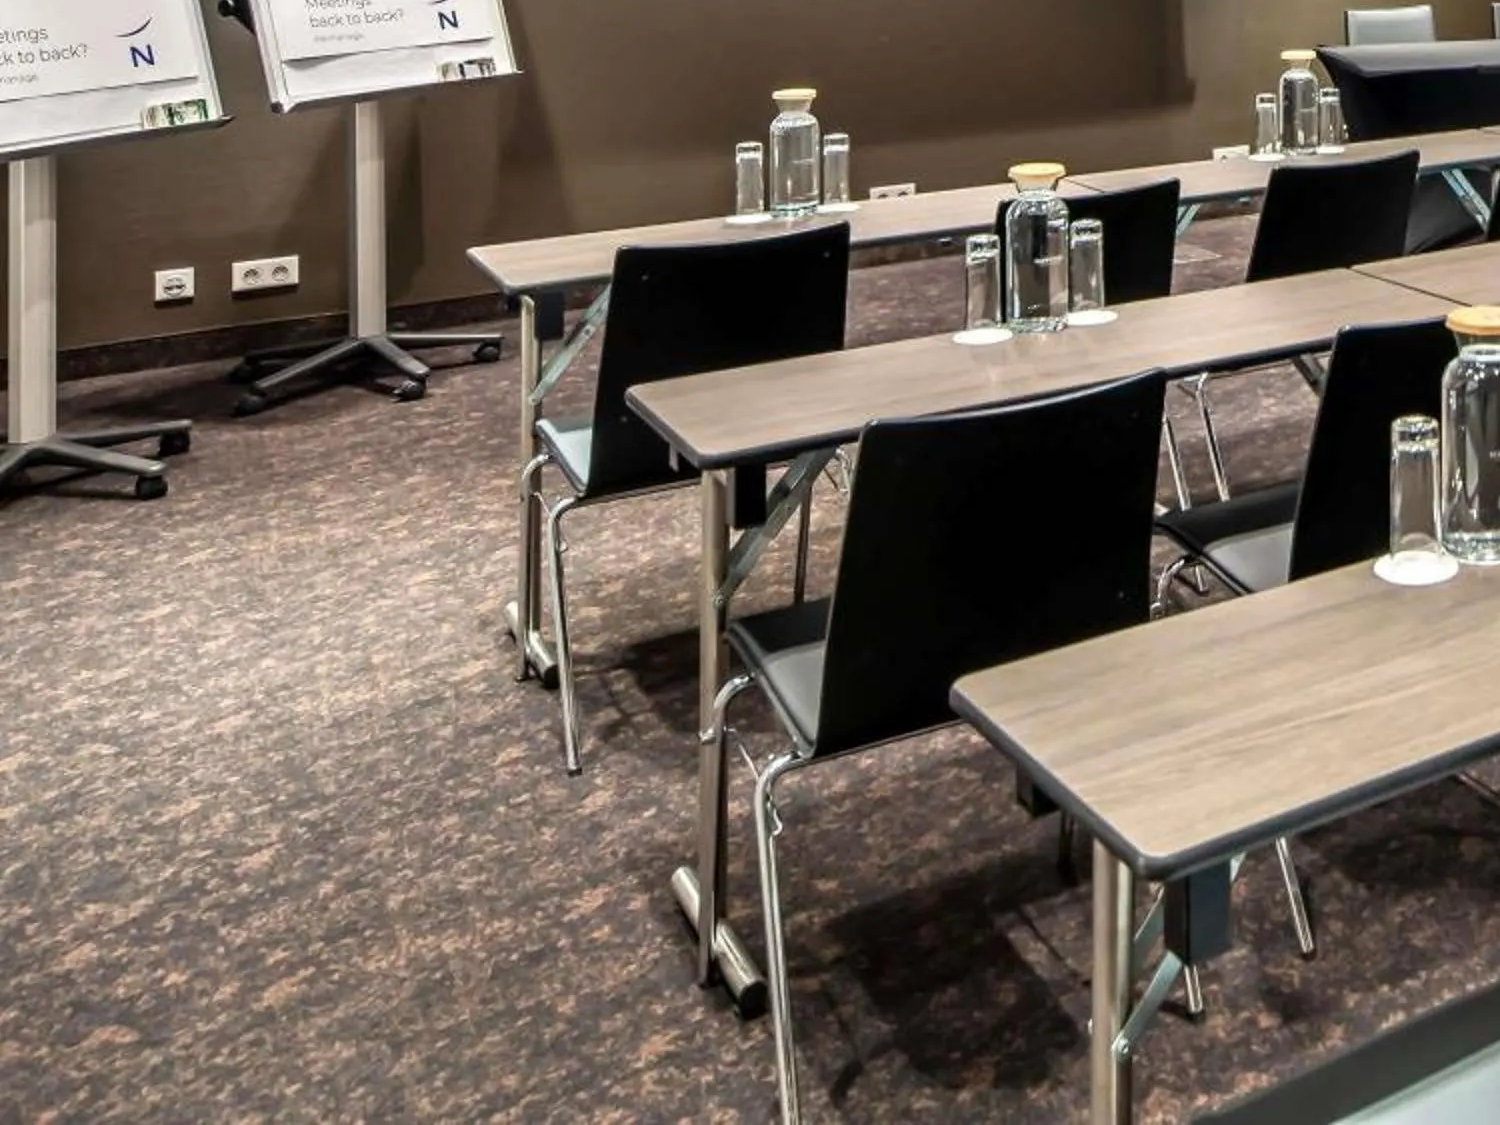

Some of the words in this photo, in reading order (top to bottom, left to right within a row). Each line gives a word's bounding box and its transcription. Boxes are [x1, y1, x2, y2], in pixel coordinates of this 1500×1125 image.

[309, 13, 344, 27] back
[346, 12, 361, 25] to
[364, 8, 404, 23] back?
[18, 50, 35, 64] to
[40, 43, 88, 62] back?
